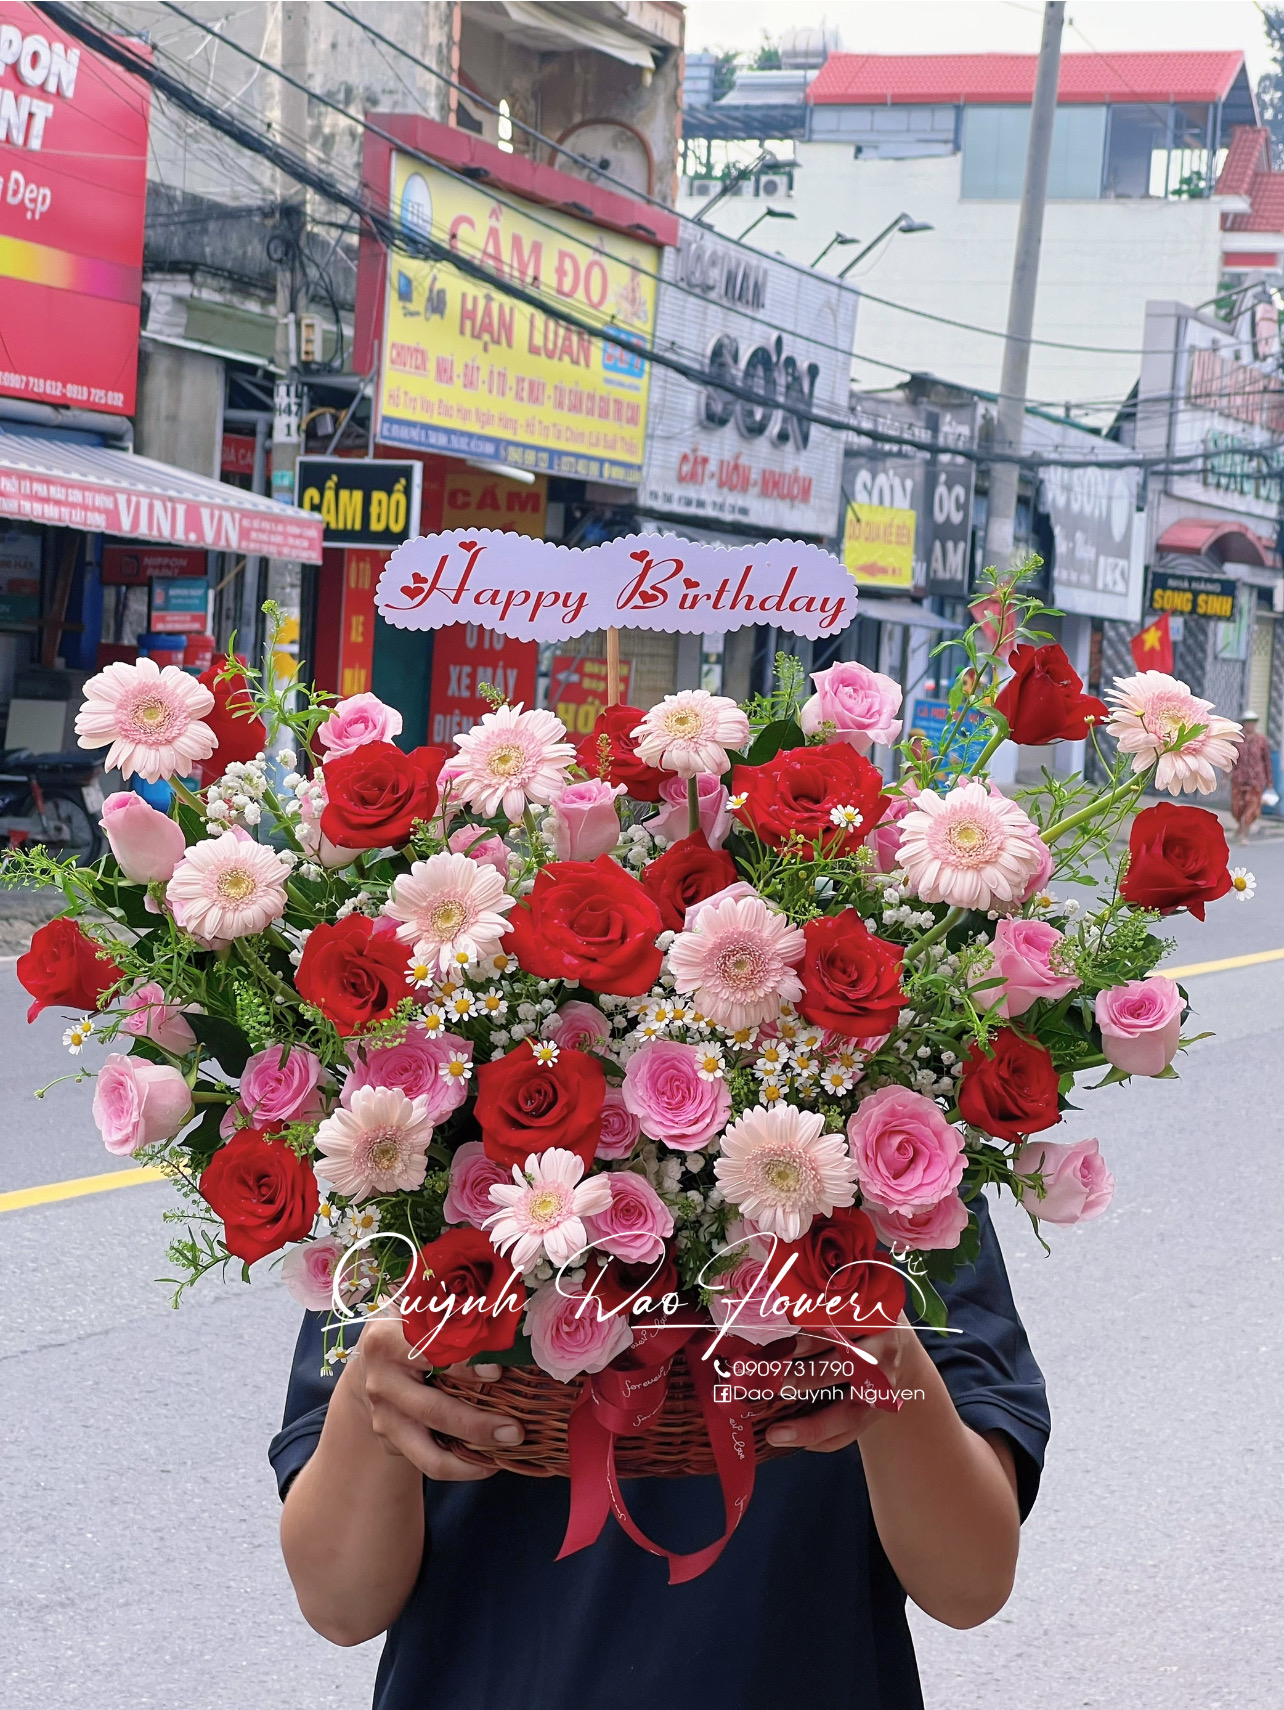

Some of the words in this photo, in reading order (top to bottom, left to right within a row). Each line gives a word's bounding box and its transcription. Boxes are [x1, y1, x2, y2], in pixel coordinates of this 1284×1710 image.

[7, 170, 51, 220] Đẹp
[116, 492, 242, 550] VINI.VN
[370, 477, 407, 533] ĐỒ
[384, 546, 589, 623] Happy
[616, 557, 847, 629] Birthday
[1152, 588, 1193, 613] SONG
[447, 664, 472, 698] XE
